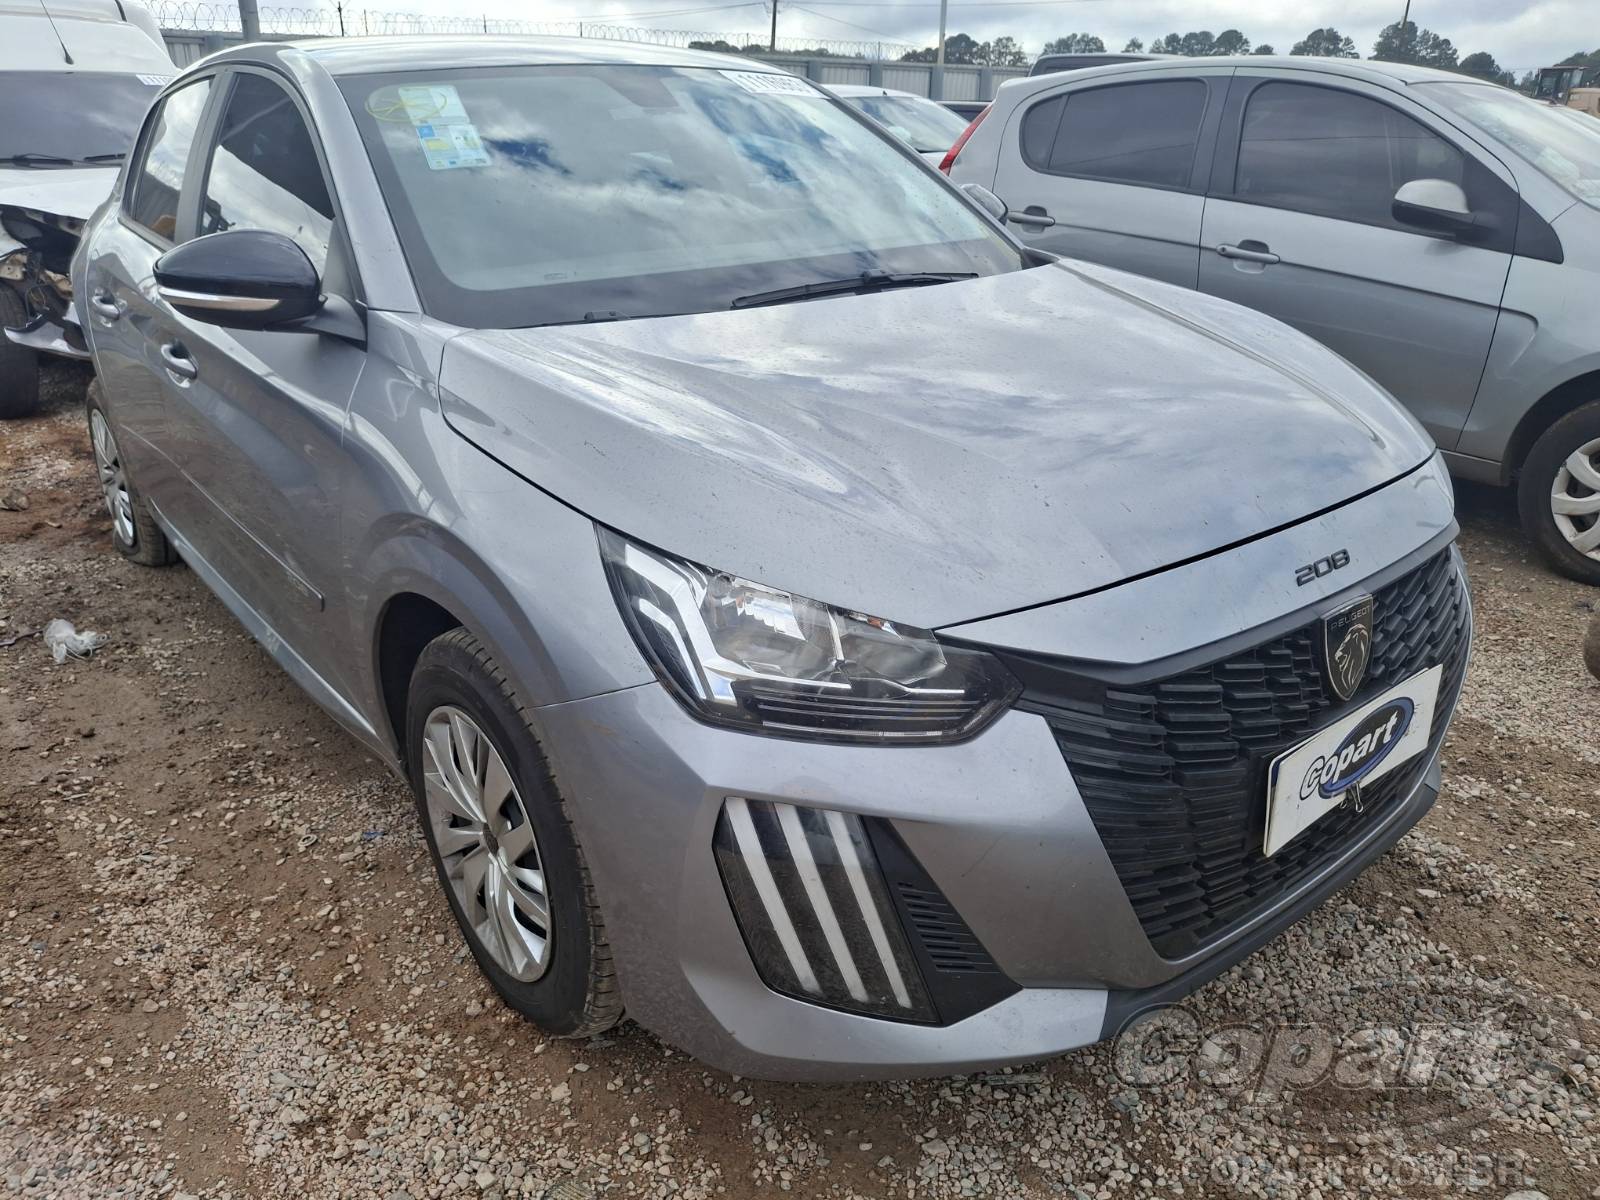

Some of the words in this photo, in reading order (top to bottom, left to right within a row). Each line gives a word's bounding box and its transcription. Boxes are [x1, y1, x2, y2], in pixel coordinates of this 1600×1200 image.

[1295, 549, 1350, 587] 208
[1330, 604, 1371, 630] PEUGEOT
[1300, 710, 1399, 800] Copart
